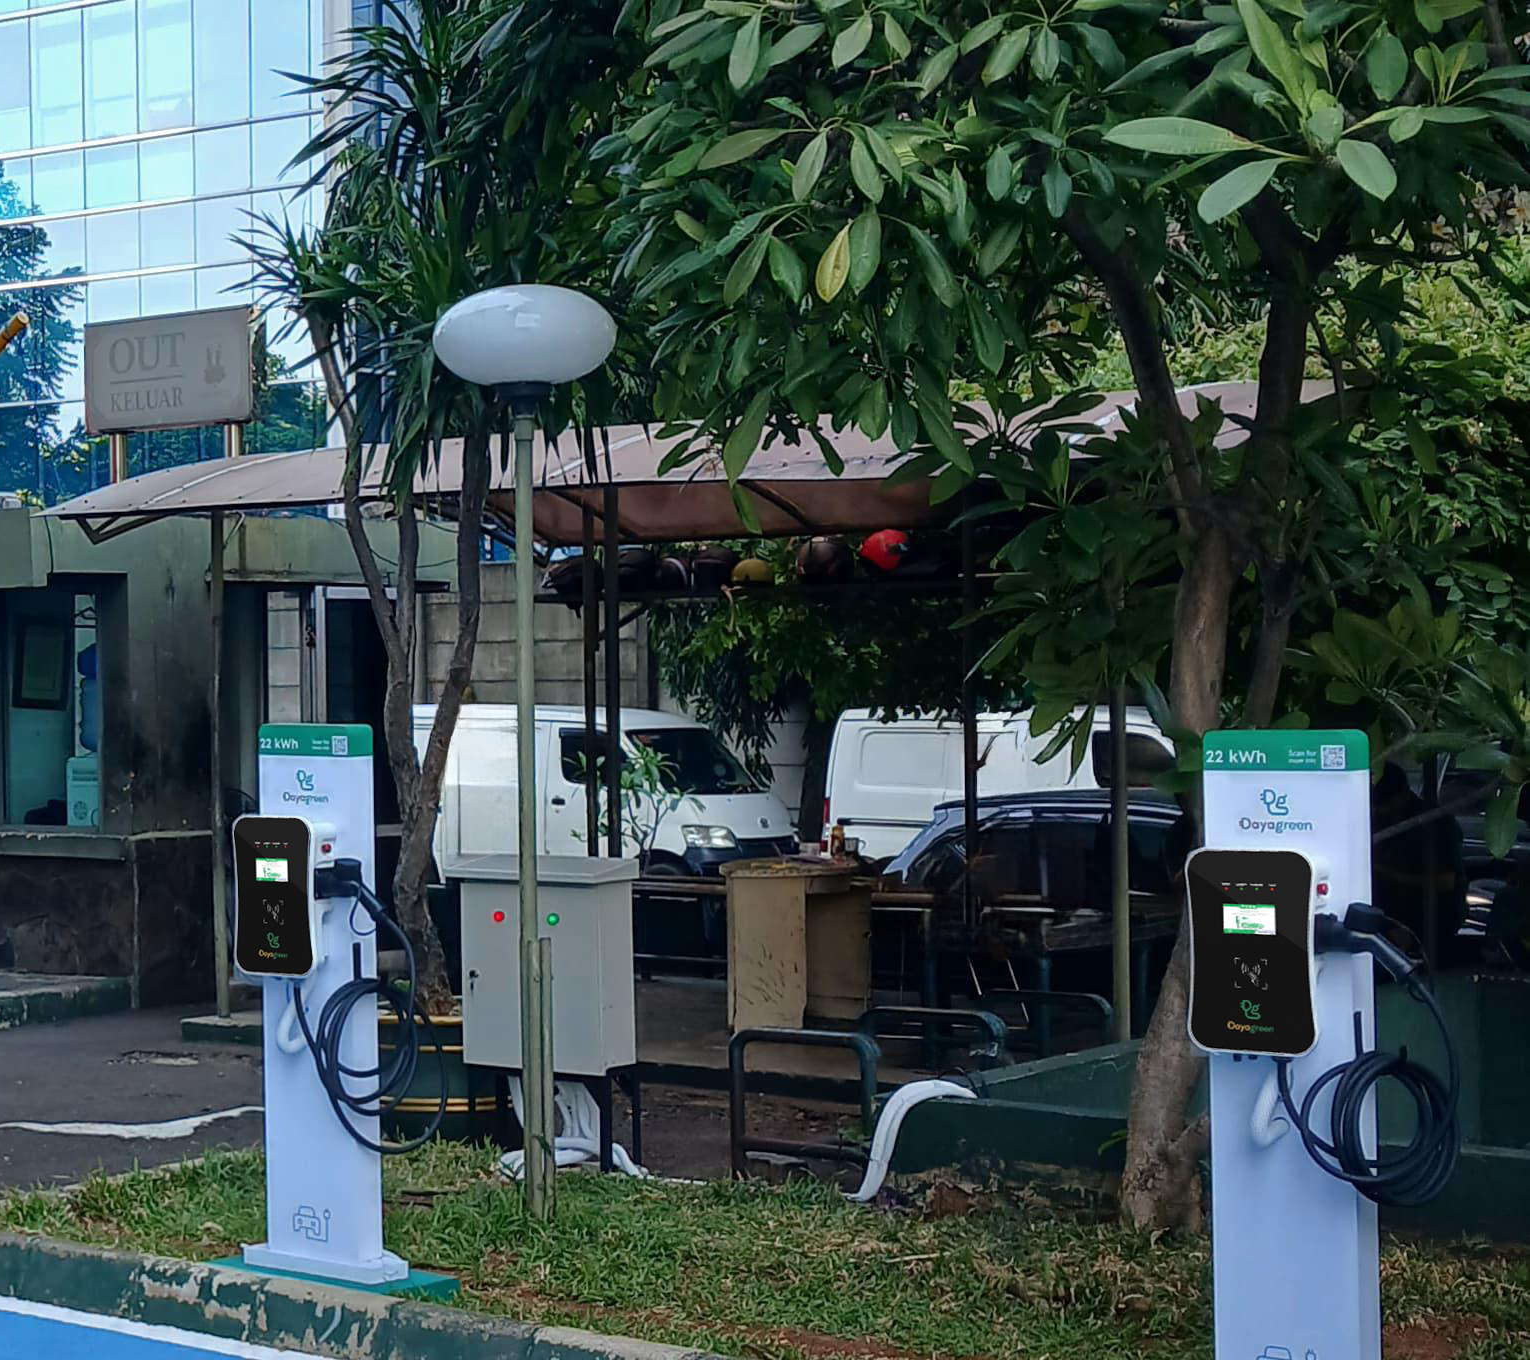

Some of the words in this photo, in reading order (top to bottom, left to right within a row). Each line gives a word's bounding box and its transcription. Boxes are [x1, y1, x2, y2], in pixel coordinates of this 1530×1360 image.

[108, 331, 186, 375] OUT
[110, 386, 184, 413] KELUAR
[260, 738, 272, 749] 22
[274, 738, 299, 750] kWh
[1206, 750, 1223, 763] 22
[1229, 749, 1267, 763] kWh
[1239, 817, 1313, 834] Dayagreen
[1226, 1020, 1274, 1034] Dayagreen
